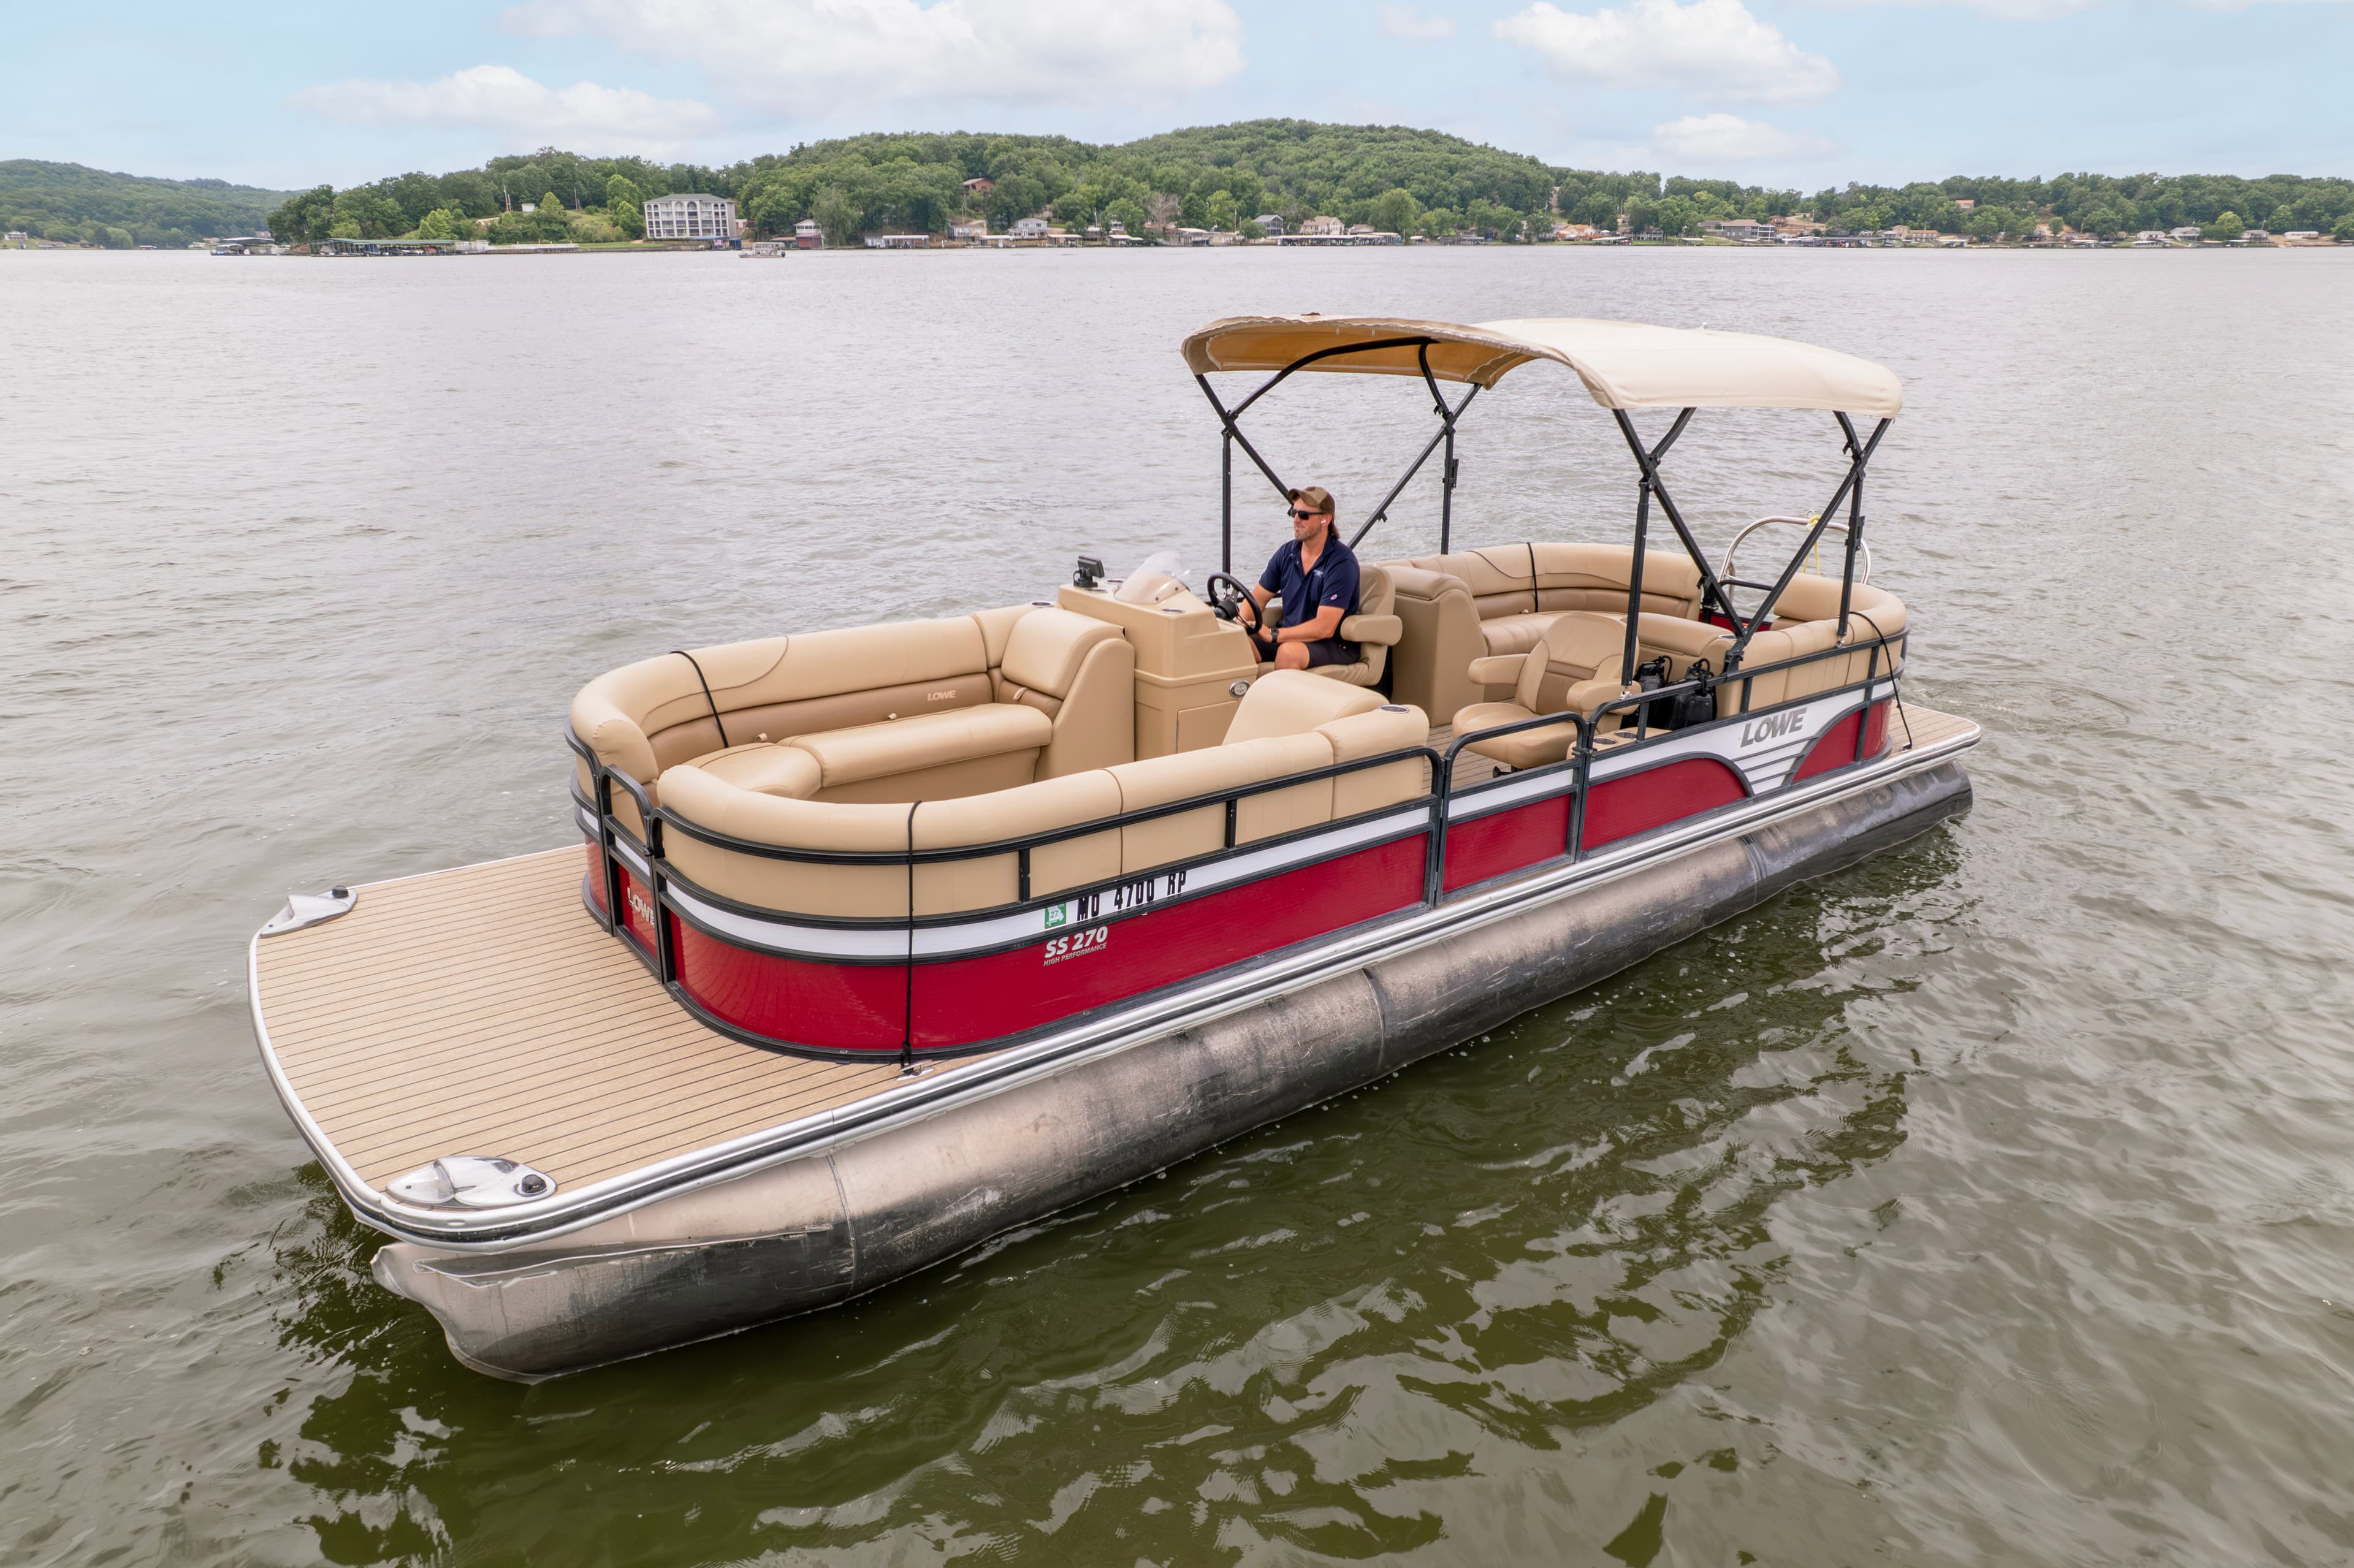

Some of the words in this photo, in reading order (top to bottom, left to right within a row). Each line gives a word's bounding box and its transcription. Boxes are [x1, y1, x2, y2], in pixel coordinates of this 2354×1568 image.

[928, 690, 956, 701] LOWE
[1740, 707, 1807, 748] LOWE
[1077, 893, 1100, 921] MO
[1114, 878, 1154, 910] 4700
[1167, 870, 1186, 896] RP
[1043, 957, 1060, 966] HIGH
[1061, 941, 1107, 961] PERFORMANCE
[1045, 936, 1068, 958] SS
[1072, 926, 1108, 951] 270
